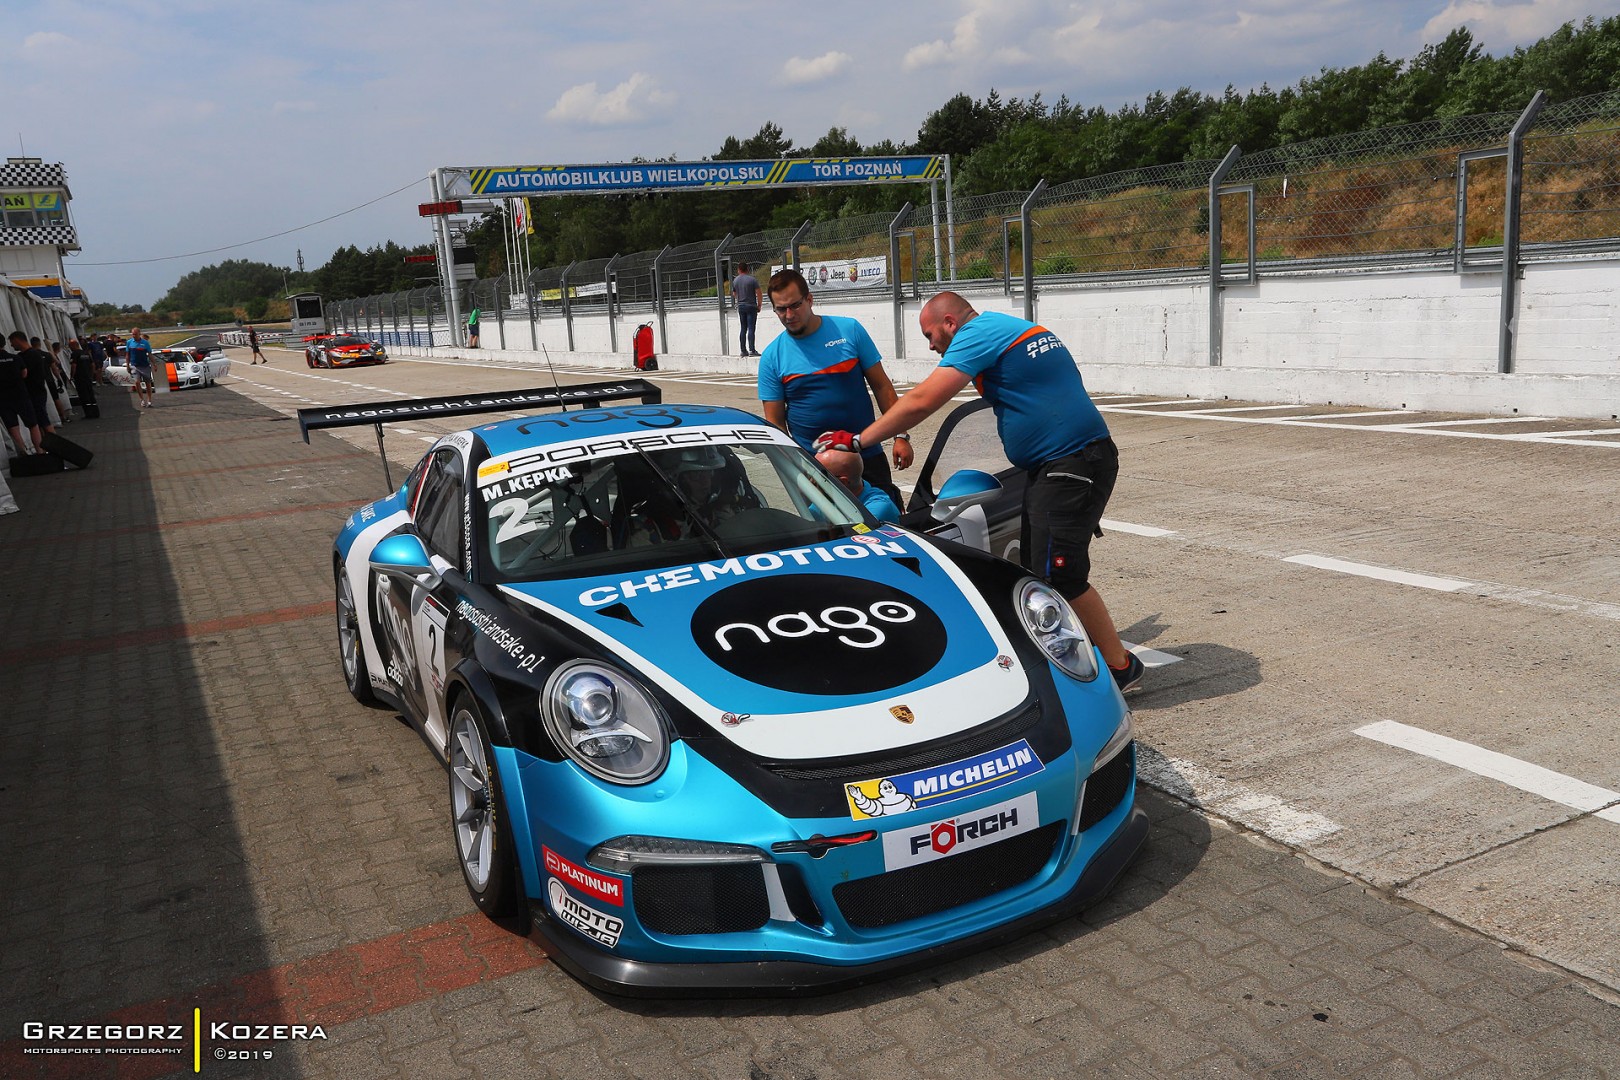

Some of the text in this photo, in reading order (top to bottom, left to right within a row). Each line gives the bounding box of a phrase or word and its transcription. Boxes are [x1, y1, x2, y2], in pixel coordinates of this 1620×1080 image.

[495, 166, 764, 188] AUTOMOBILKLUB WIELKOPOLSKI
[812, 160, 903, 177] TOR POZNAŃ
[830, 267, 881, 281] Jeep IVECO
[325, 385, 633, 420] nagosushiandsake.pl
[516, 404, 717, 435] nago
[507, 429, 775, 474] PORSCHE
[481, 466, 573, 503] M.KĘPKA
[488, 497, 538, 545] 2
[578, 541, 908, 607] CHEMOTION
[455, 599, 546, 674] nagosushiandsake.pl
[714, 600, 917, 651] nago
[428, 624, 441, 676] 2
[913, 747, 1033, 797] MICHELIN
[561, 862, 619, 897] PLATINUM
[561, 909, 618, 947] WIZJA
[564, 896, 622, 934] MOTO
